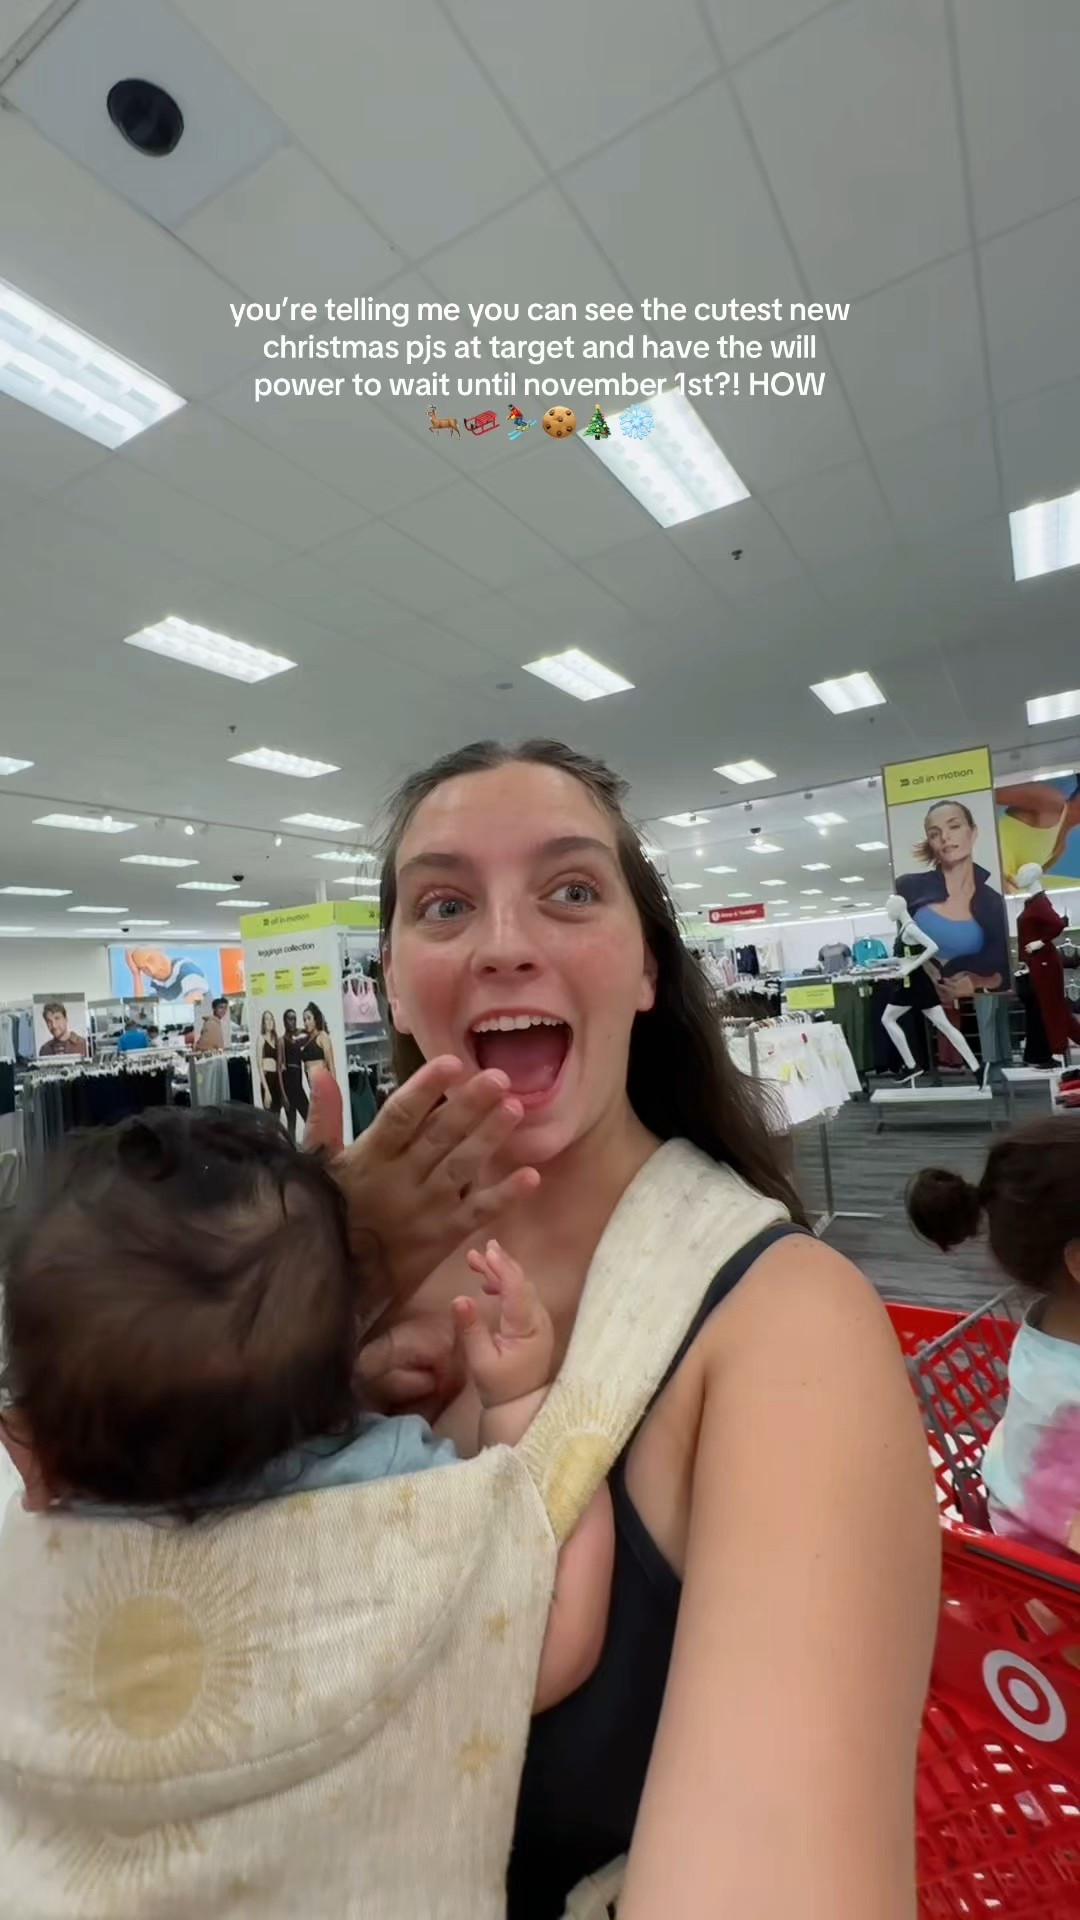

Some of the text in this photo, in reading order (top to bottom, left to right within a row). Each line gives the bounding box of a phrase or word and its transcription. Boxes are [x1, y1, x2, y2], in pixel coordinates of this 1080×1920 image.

[912, 767, 974, 785] all in motion
[270, 916, 279, 925] all
[287, 913, 310, 923] motion
[258, 942, 315, 958] leggings collection
